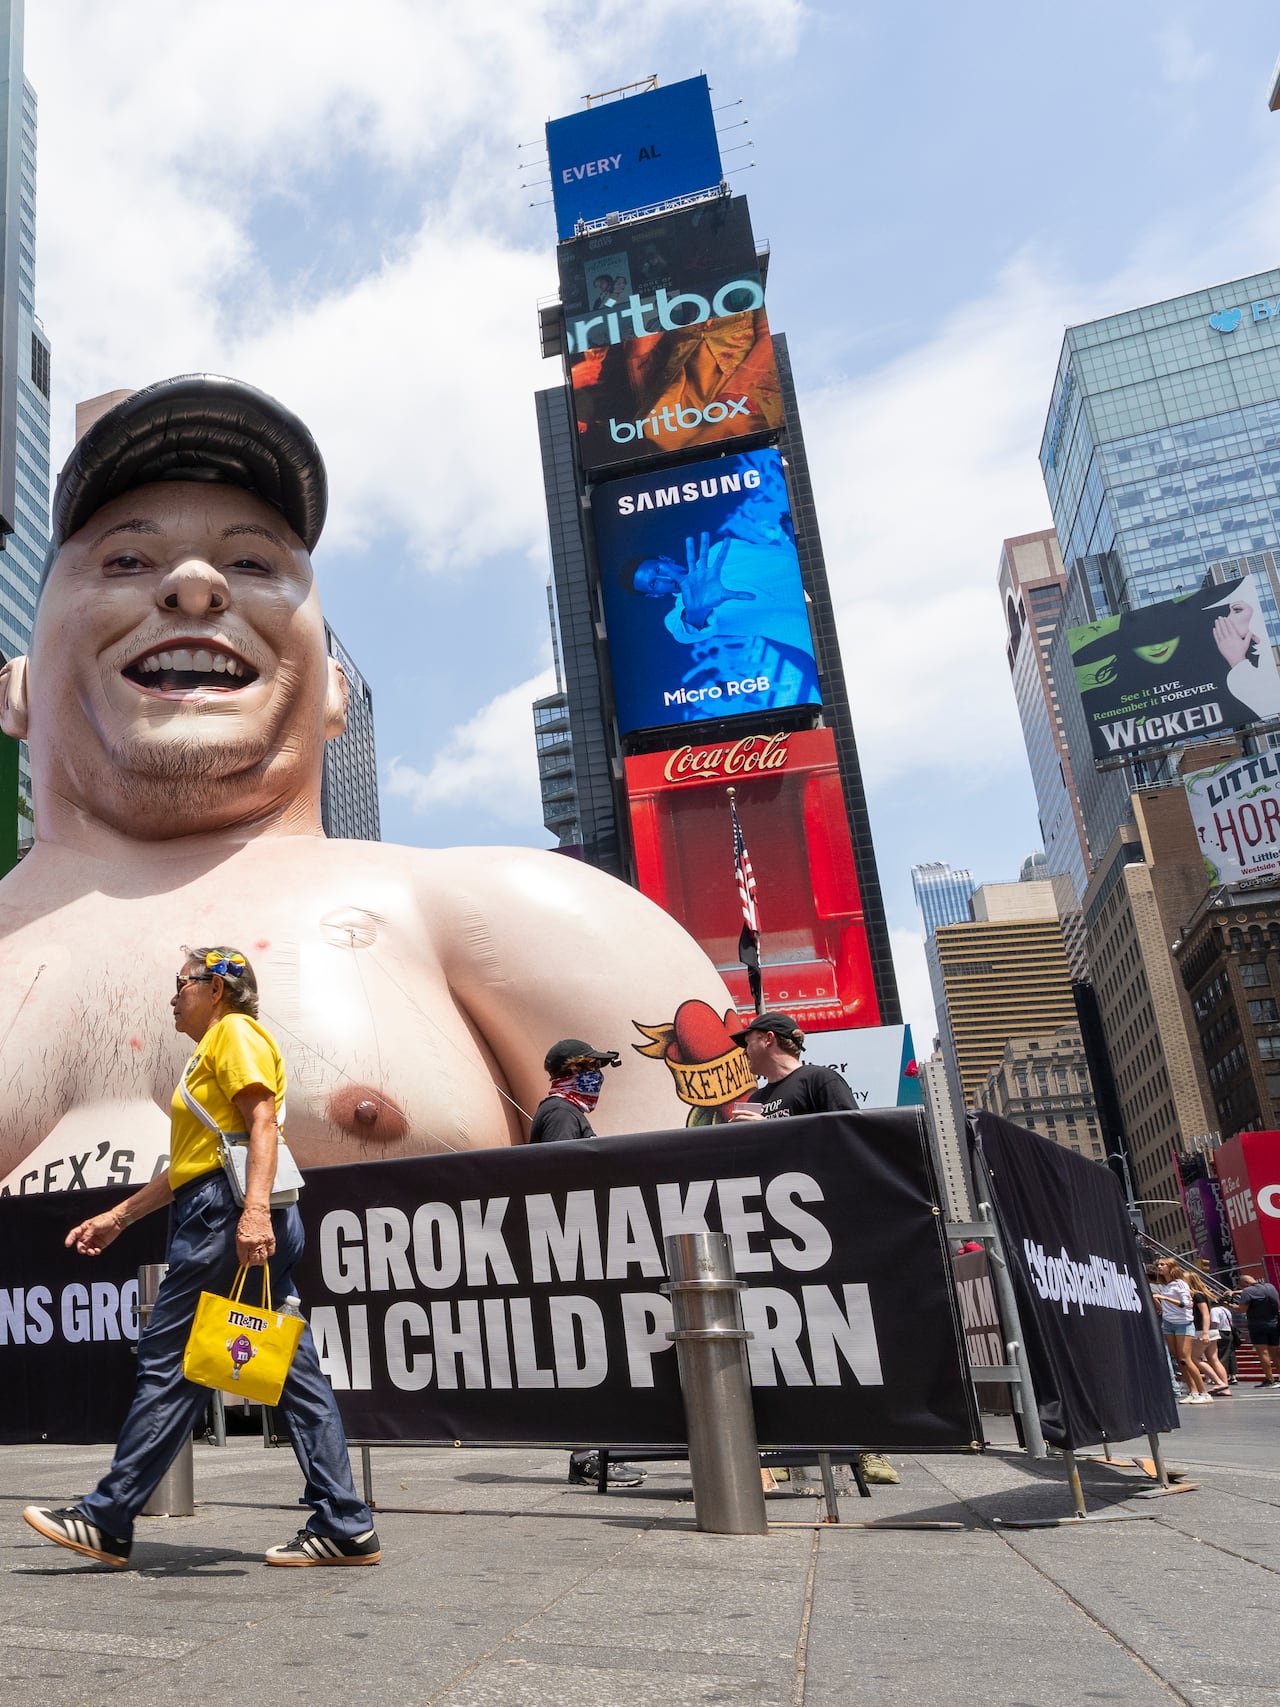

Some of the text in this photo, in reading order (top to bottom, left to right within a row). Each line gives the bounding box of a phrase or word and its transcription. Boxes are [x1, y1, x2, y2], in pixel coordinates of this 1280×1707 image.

[562, 154, 623, 184] EVERY
[609, 396, 751, 444] britbox
[618, 469, 761, 515] SAMSUNG
[664, 676, 770, 706] Micro RGB
[1092, 682, 1218, 721] Remember it FOREVER.
[1120, 680, 1184, 703] See it LIVE.
[663, 731, 792, 783] Coca-Cola
[1225, 1187, 1258, 1230] FIVE
[320, 1171, 834, 1295] GROK MAKES
[310, 1304, 372, 1390] AI
[384, 1294, 609, 1392] CHILD
[622, 1282, 884, 1389] PRN
